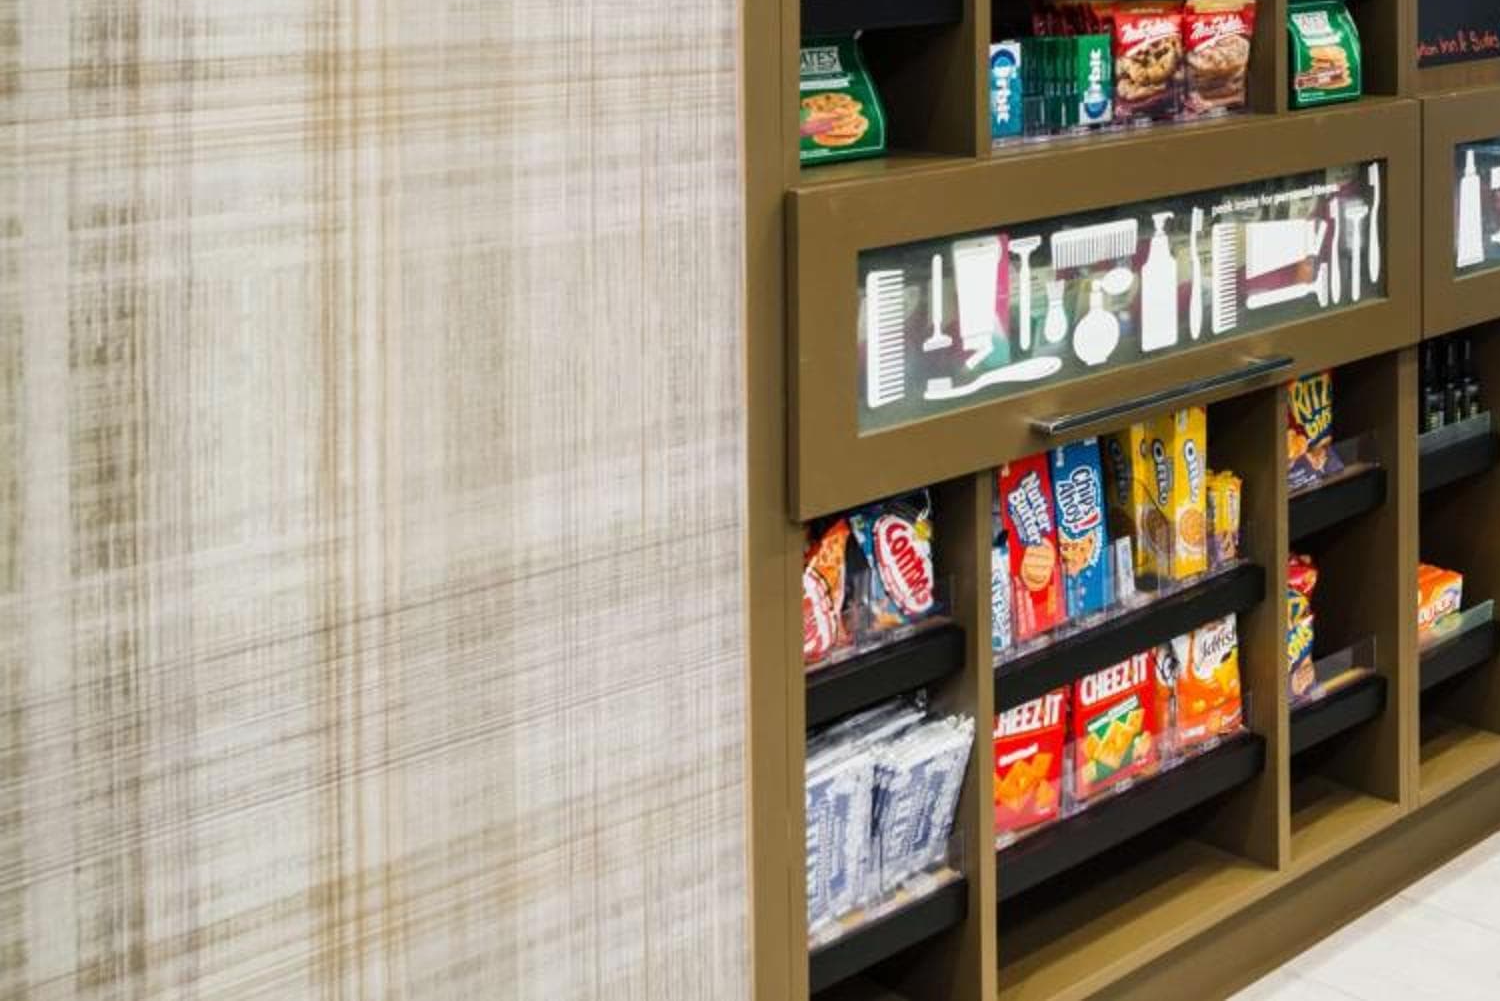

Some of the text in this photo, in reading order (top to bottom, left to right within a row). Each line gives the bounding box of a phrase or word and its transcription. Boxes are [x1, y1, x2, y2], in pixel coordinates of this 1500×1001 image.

[1008, 488, 1041, 545] Butter
[1020, 471, 1051, 532] Nutter
[1070, 466, 1099, 517] Chips
